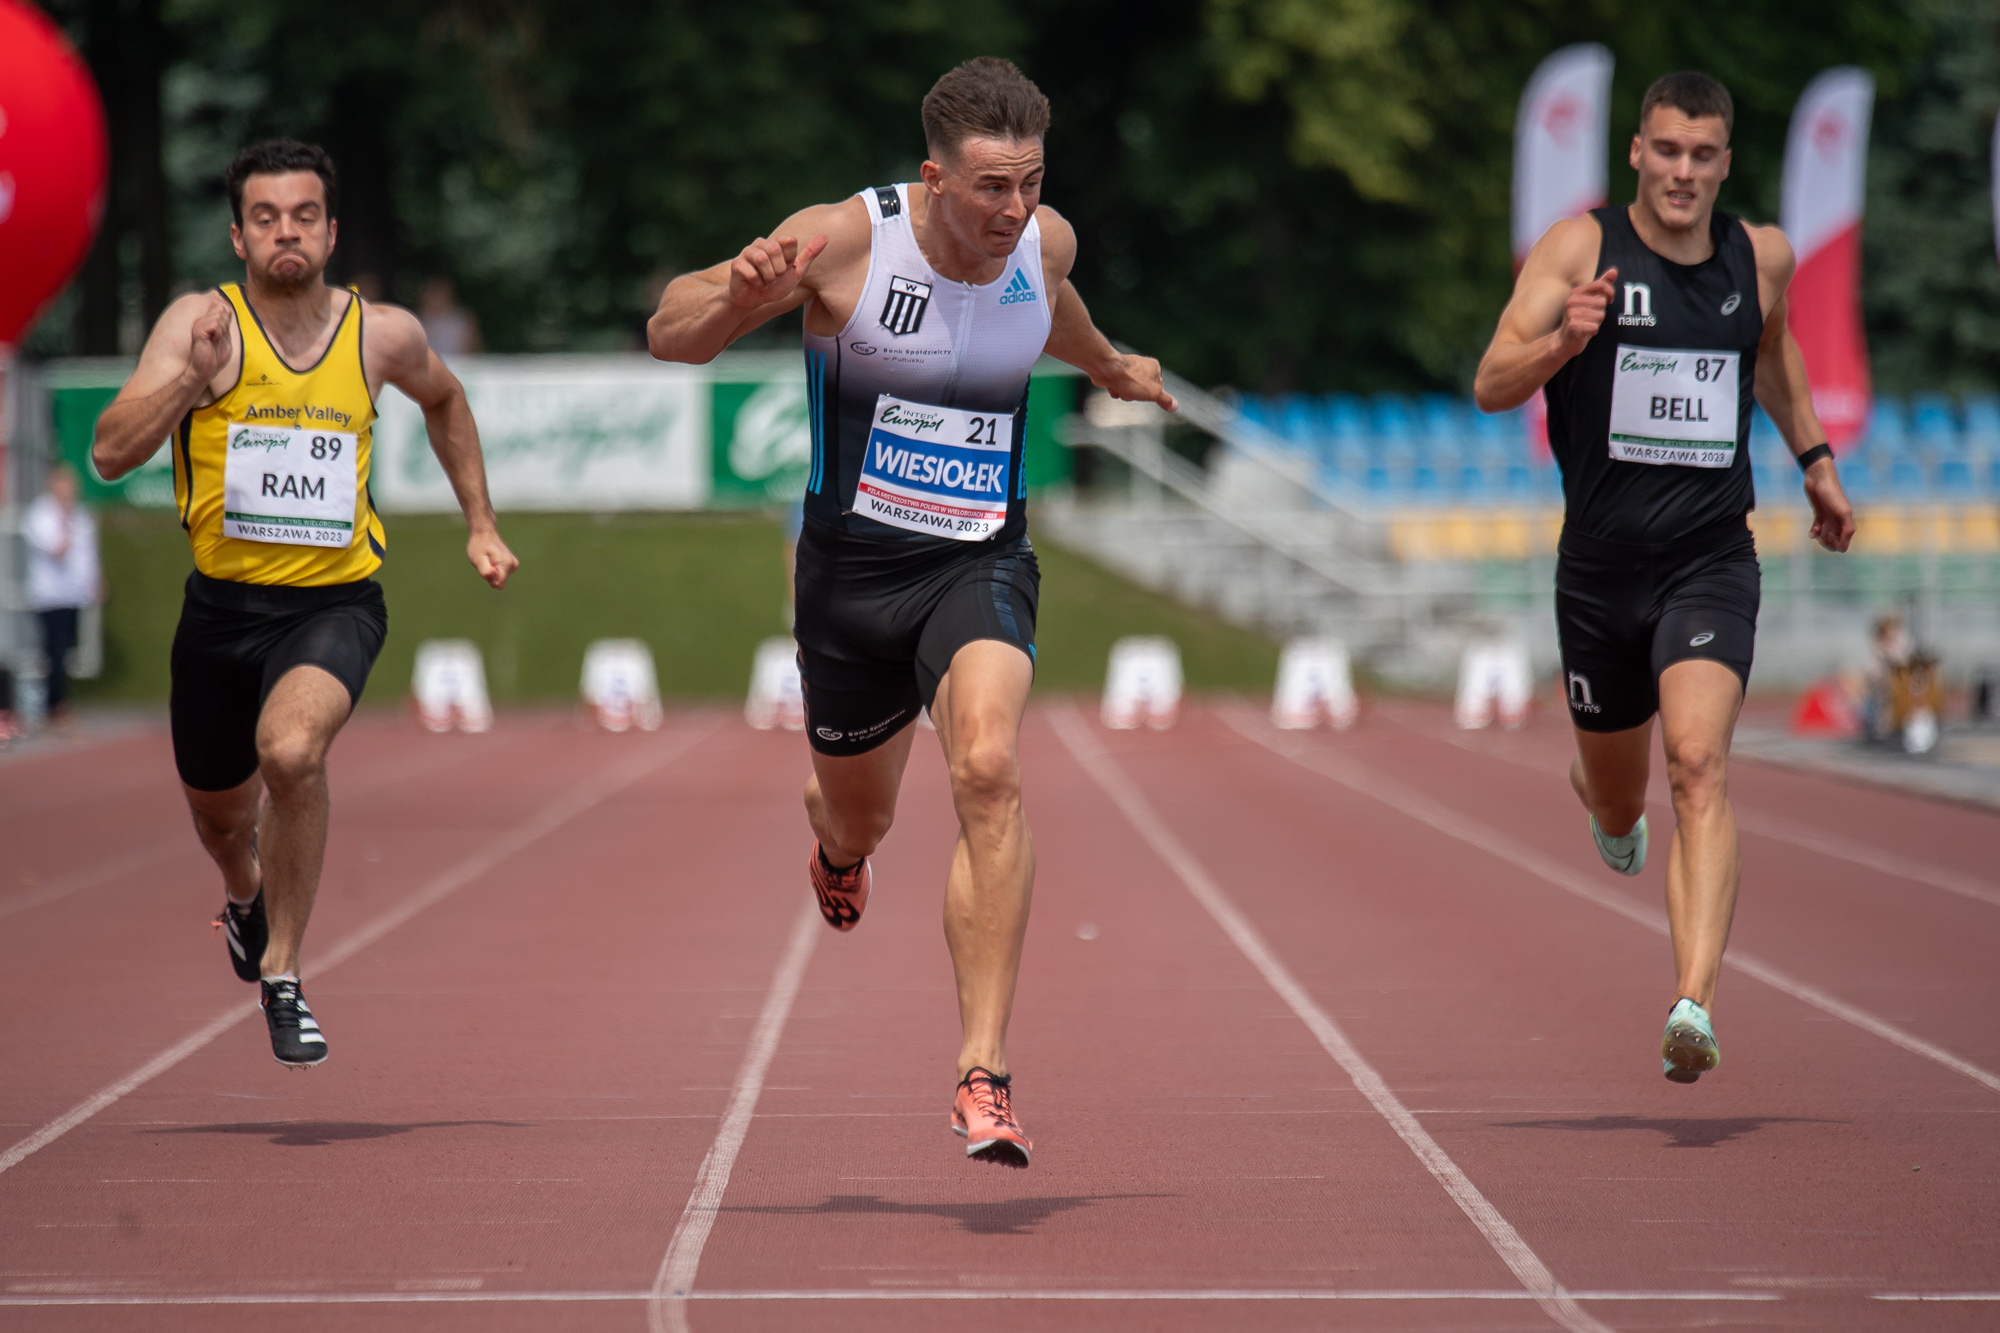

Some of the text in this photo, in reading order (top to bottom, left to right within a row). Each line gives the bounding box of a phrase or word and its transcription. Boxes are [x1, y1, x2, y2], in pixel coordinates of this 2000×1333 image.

[905, 282, 917, 292] W
[999, 290, 1037, 305] adidas
[1624, 282, 1651, 316] n
[1617, 314, 1657, 327] nairn's
[1619, 352, 1678, 377] Europol
[1694, 358, 1727, 383] 87
[245, 404, 353, 427] Amber Valley
[880, 404, 945, 434] Europol
[1650, 396, 1709, 422] BELL
[232, 428, 291, 454] Europol
[965, 417, 997, 446] 21
[310, 436, 342, 461] 89
[1623, 446, 1725, 463] WARSZAWA 2023
[875, 441, 1004, 494] WIESIOŁEK
[262, 473, 325, 501] RAM
[867, 486, 880, 497] PZLA
[880, 491, 920, 508] MISTRZOSTWA
[920, 502, 940, 512] POLSKI
[947, 508, 984, 518] WIELOBOJACH
[870, 498, 990, 533] WARSZAWA 2023
[236, 523, 343, 543] WARSZAWA 2023
